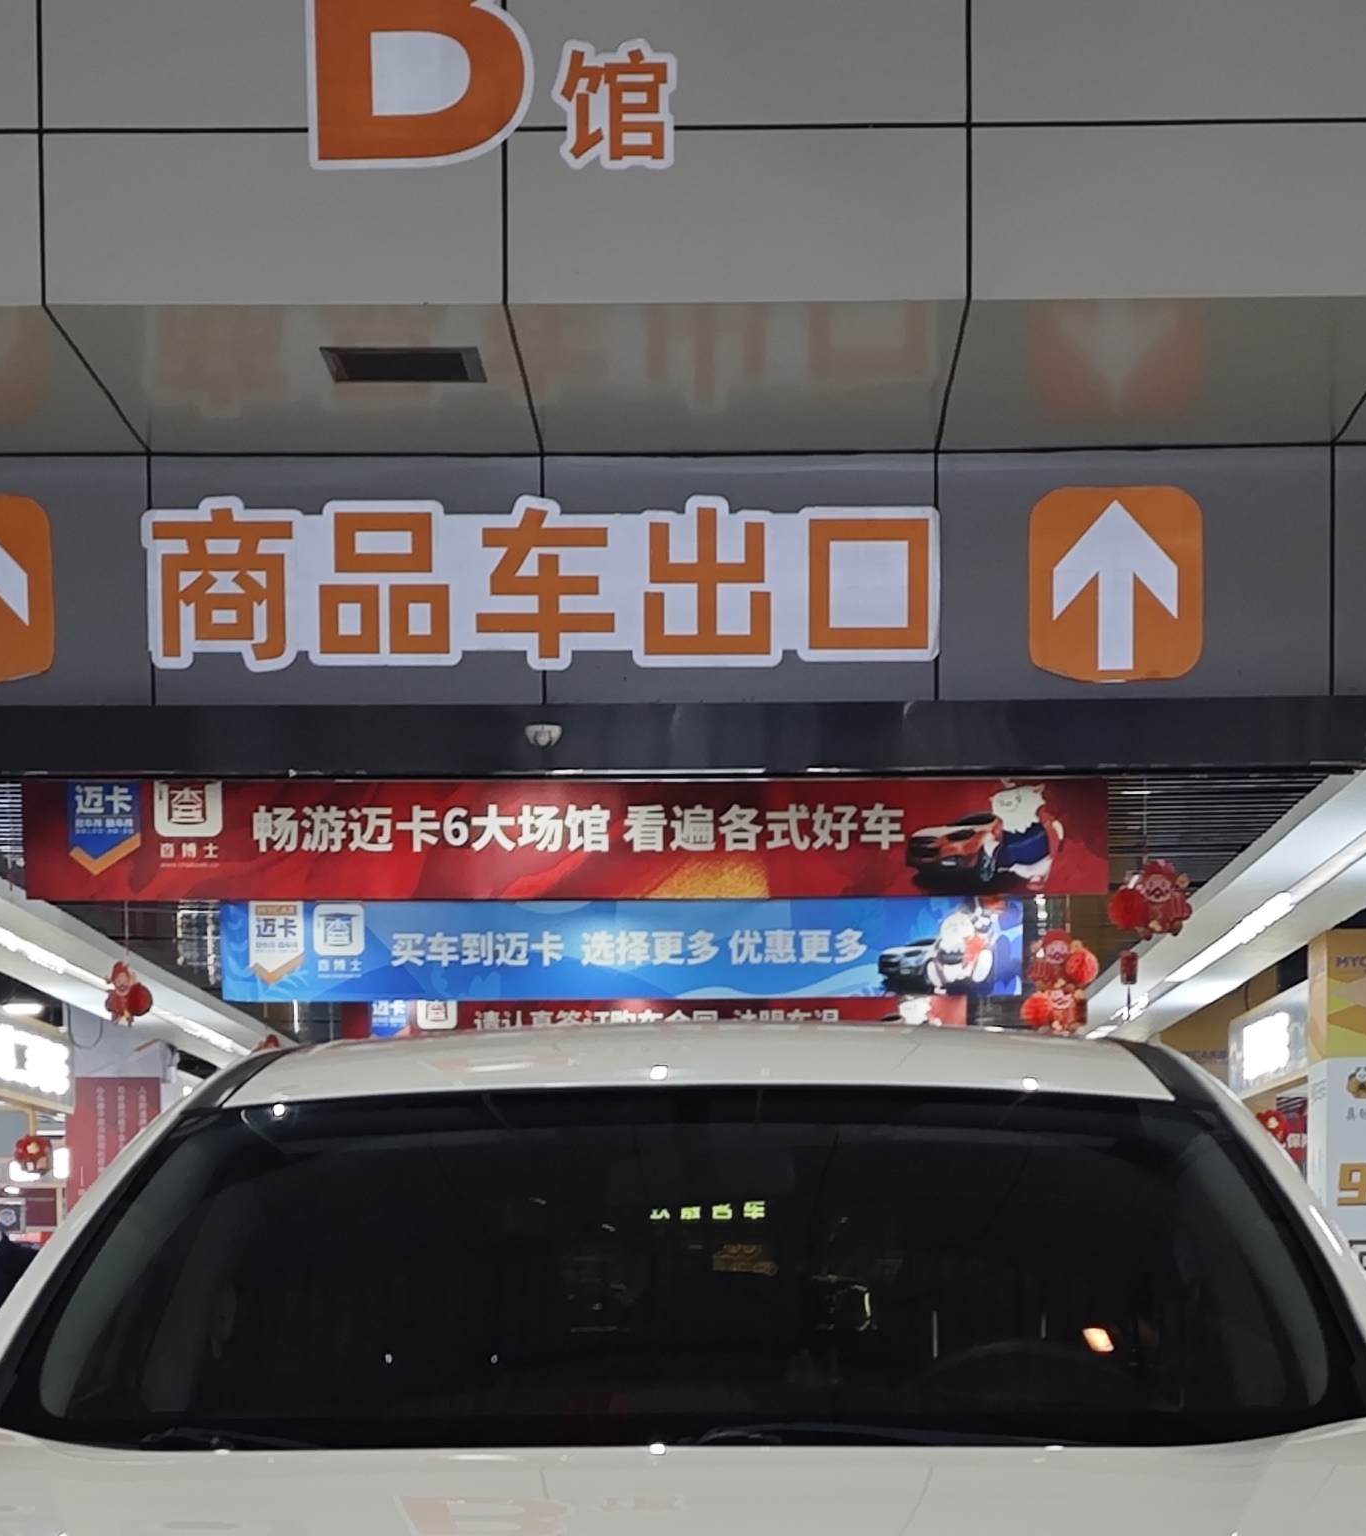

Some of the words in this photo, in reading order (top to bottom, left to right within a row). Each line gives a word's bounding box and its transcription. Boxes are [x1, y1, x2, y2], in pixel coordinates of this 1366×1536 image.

[143, 497, 939, 670] 商品车出口
[74, 784, 133, 815] 迈卡
[251, 803, 611, 853] 畅游迈卡6大场馆
[622, 803, 907, 852] 看遍各式好车
[256, 917, 297, 938] 迈卡
[390, 931, 565, 967] 买车到迈卡
[580, 930, 720, 966] 选择更多
[727, 928, 868, 966] 优惠更多
